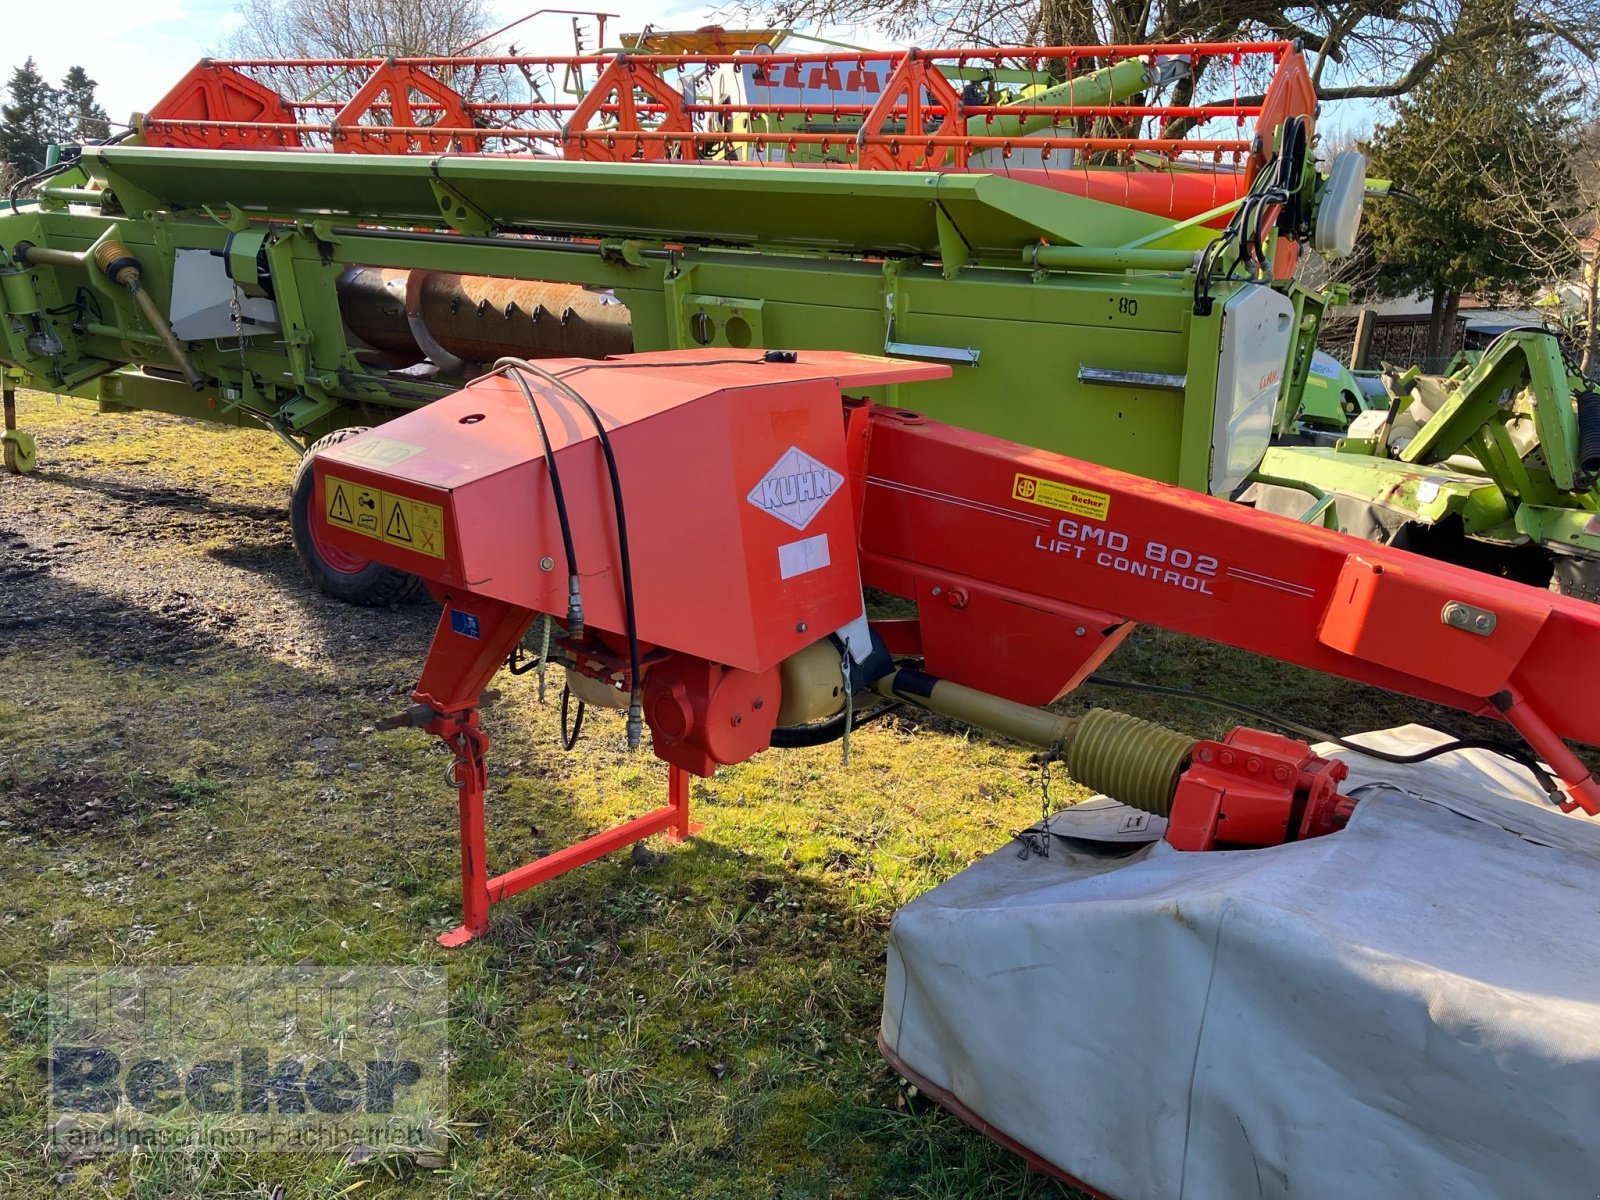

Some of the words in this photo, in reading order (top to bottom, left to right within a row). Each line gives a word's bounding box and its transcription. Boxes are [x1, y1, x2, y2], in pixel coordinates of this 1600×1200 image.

[754, 65, 908, 95] CLAA
[1119, 297, 1137, 316] 80
[761, 468, 832, 509] KUHN
[1071, 494, 1104, 508] Becker
[1035, 535, 1086, 560] LIFT
[1096, 552, 1213, 595] CONTROL
[1057, 518, 1129, 552] GMD
[1145, 541, 1219, 577] 802
